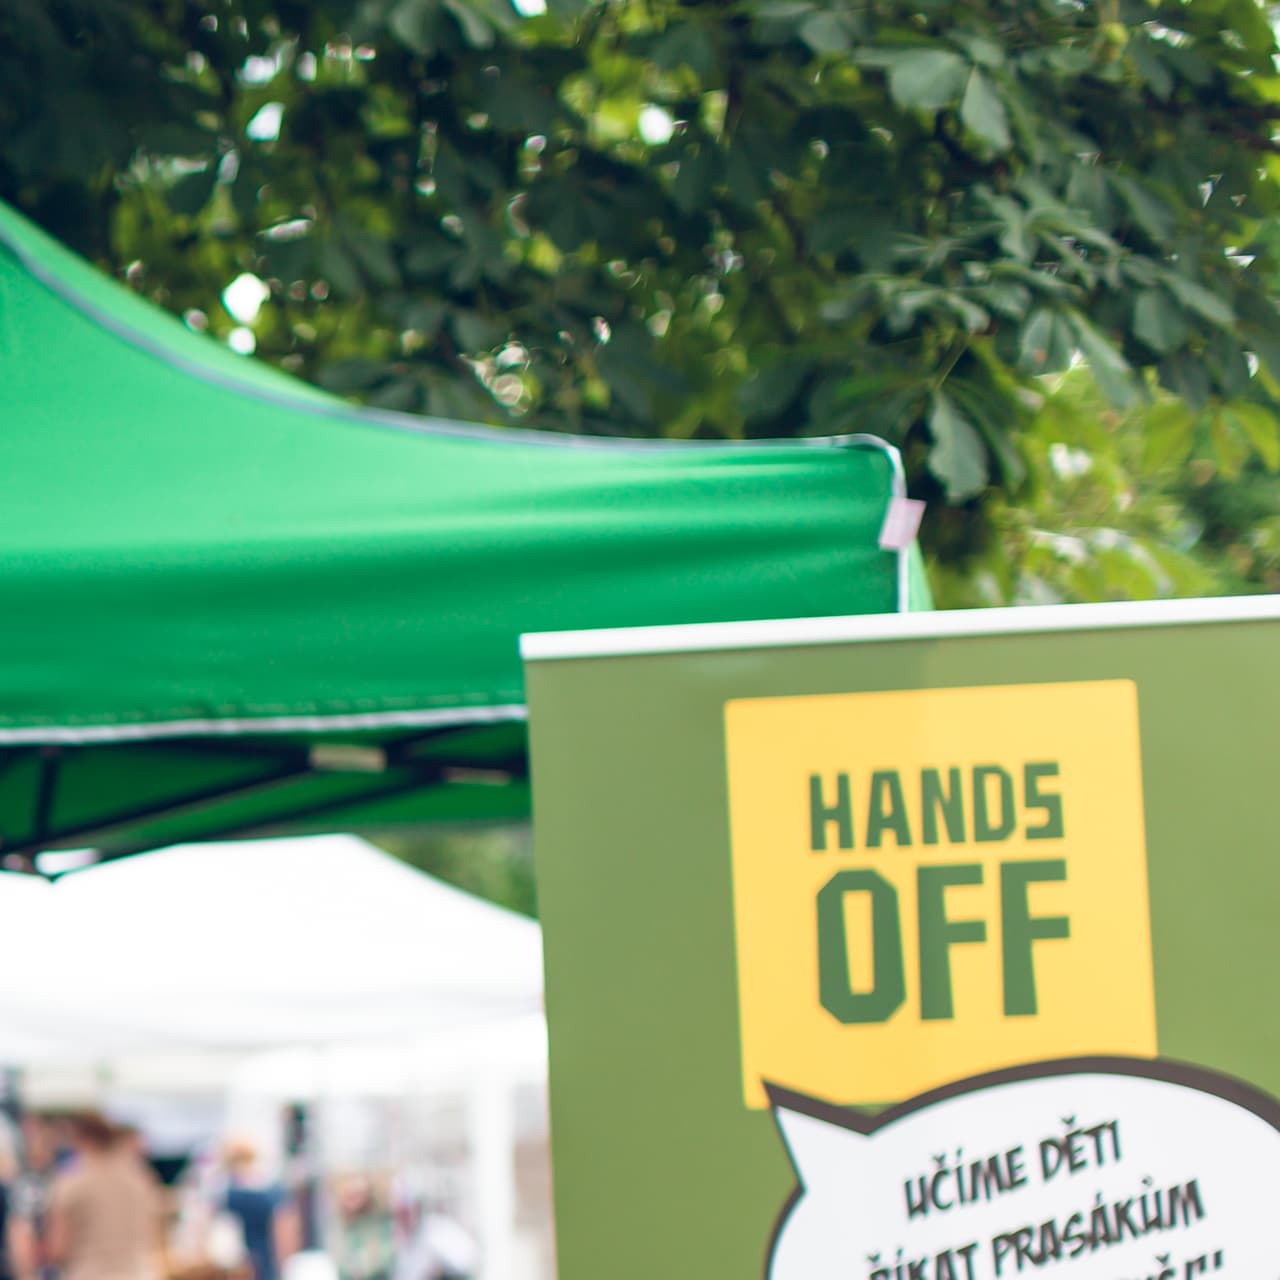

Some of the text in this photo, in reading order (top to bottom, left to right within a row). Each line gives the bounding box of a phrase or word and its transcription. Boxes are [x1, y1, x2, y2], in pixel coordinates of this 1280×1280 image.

[809, 761, 1065, 851] HANDS
[815, 858, 1071, 1025] OFF
[904, 1114, 1122, 1221] UČÍME DĚTI
[992, 1175, 1206, 1279] PRASÁKŮM
